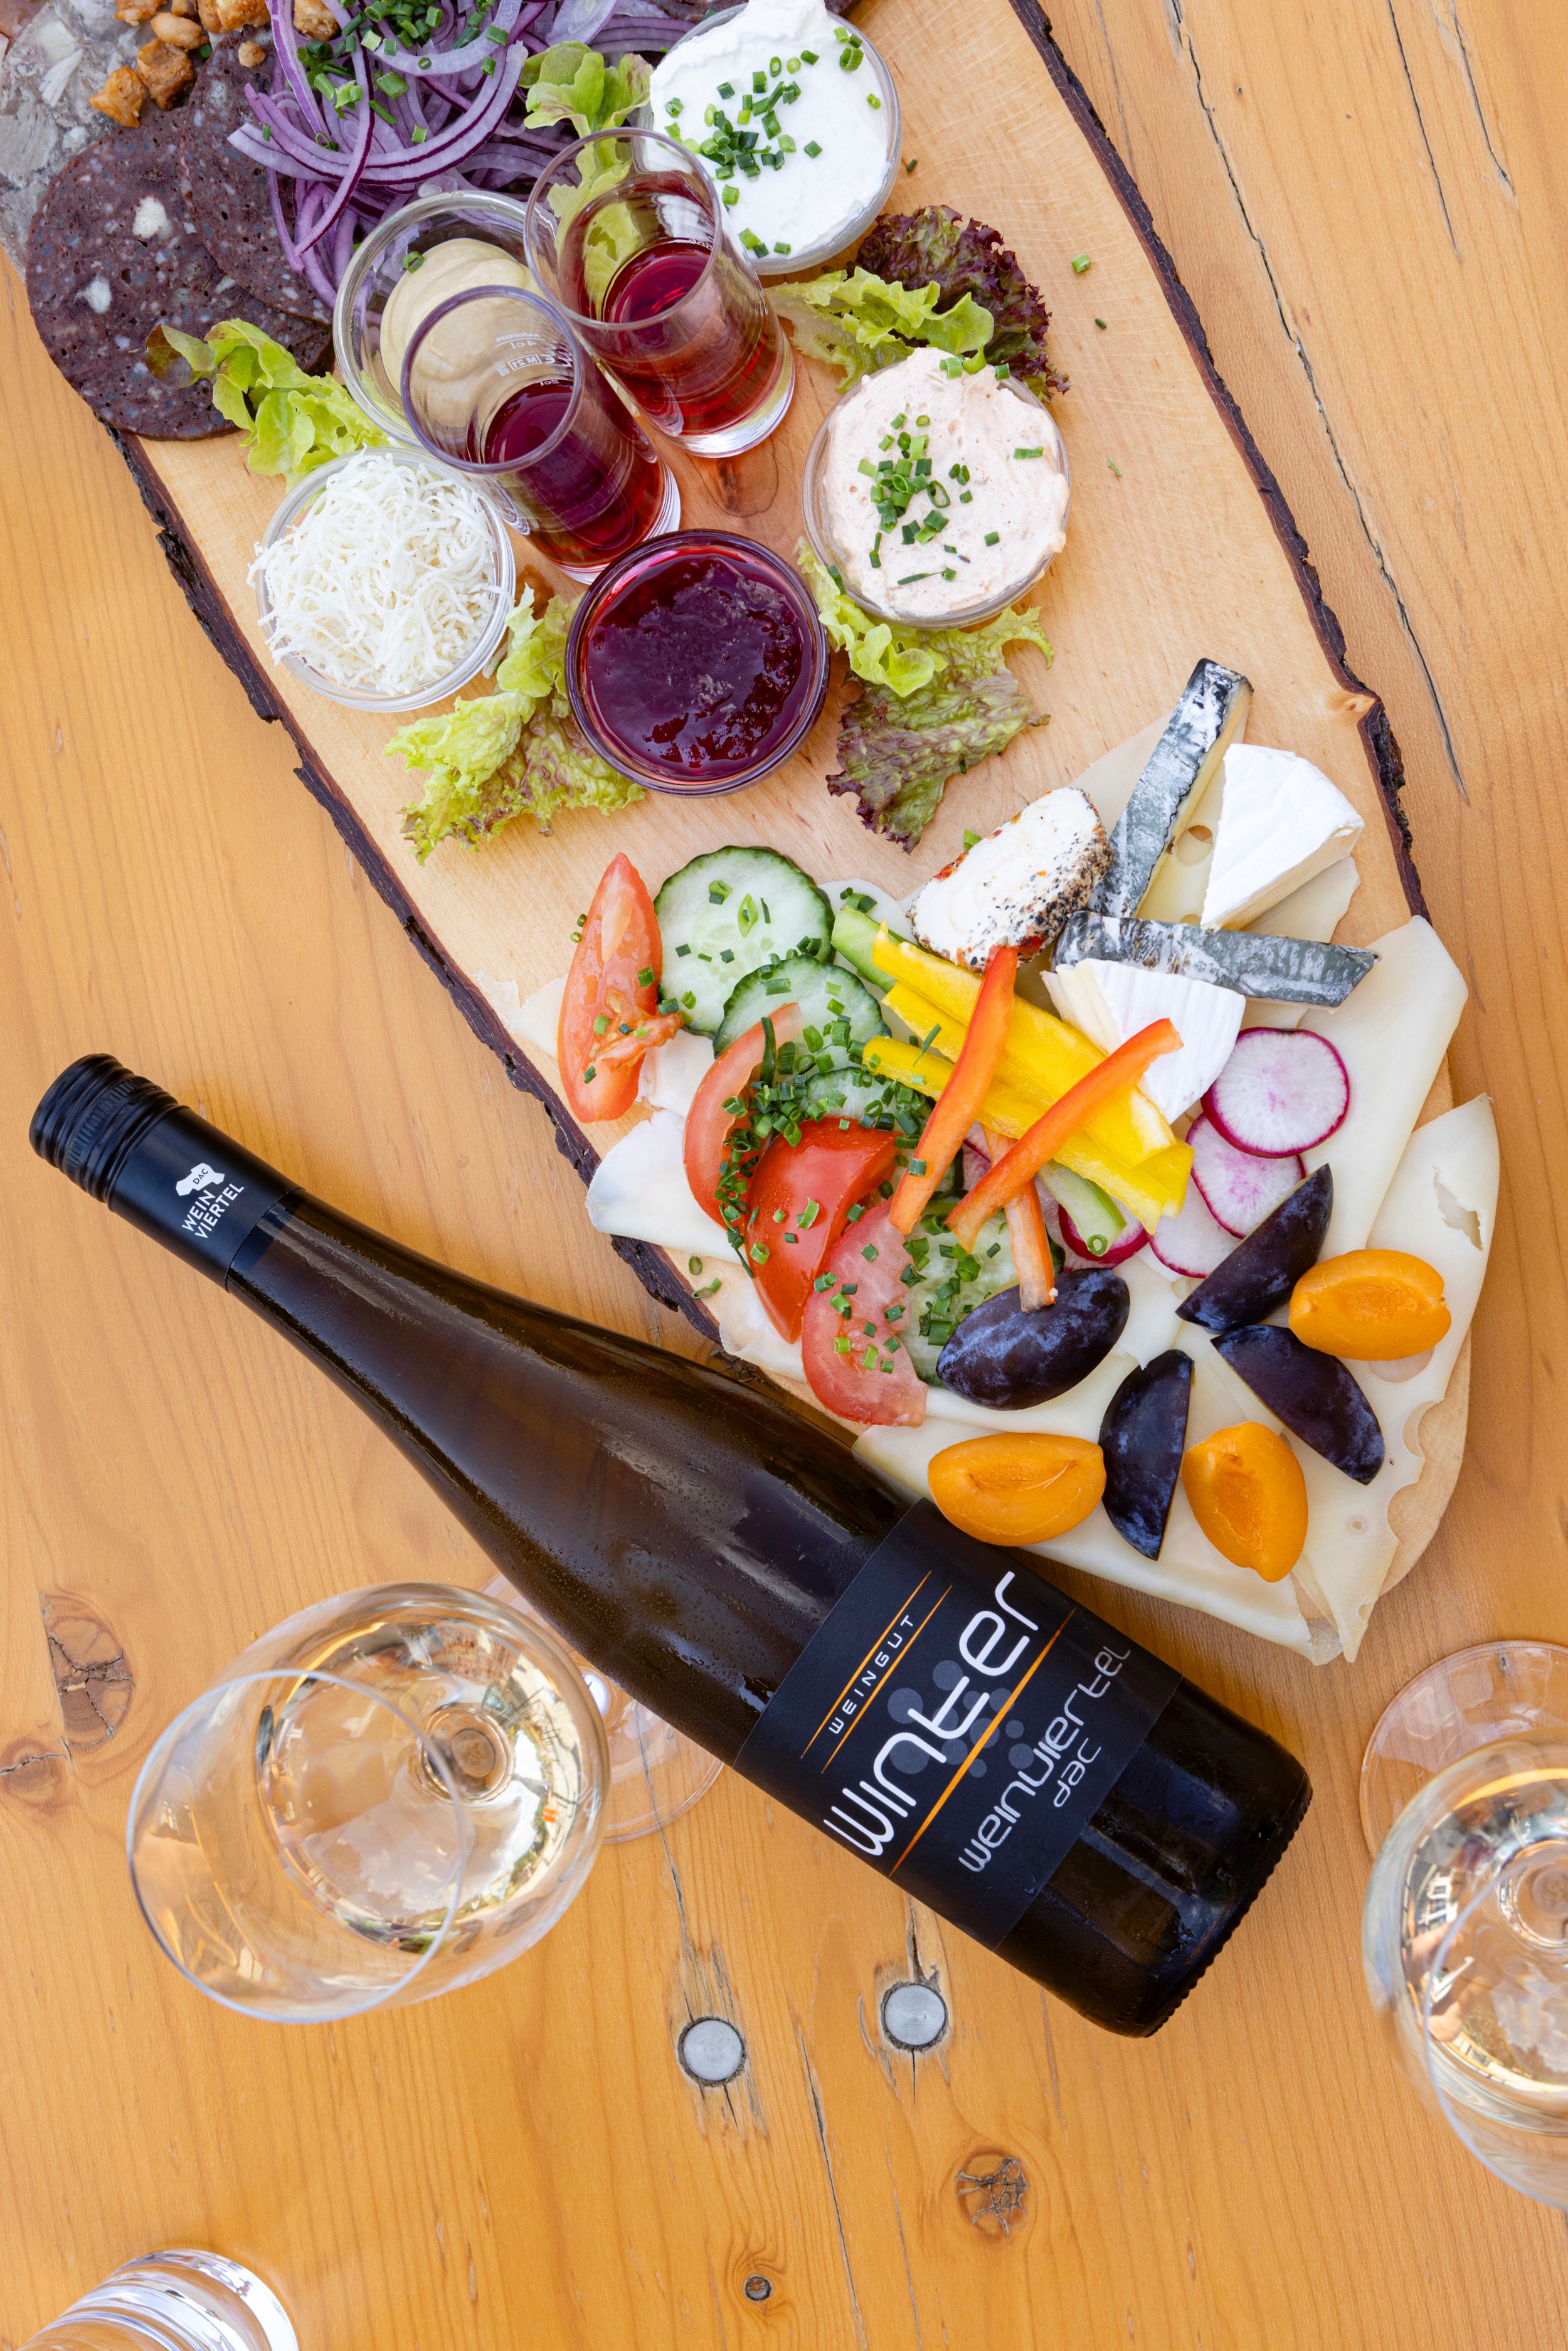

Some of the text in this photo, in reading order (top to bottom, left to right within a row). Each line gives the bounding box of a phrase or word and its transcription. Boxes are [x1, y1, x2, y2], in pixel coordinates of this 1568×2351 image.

[193, 1168, 209, 1185] DAC
[181, 1189, 216, 1232] WEIN
[194, 1183, 245, 1239] VIERTEL
[828, 1615, 914, 1735] WEINGUT
[823, 1571, 1039, 1856] winter
[1053, 1738, 1101, 1808] dac
